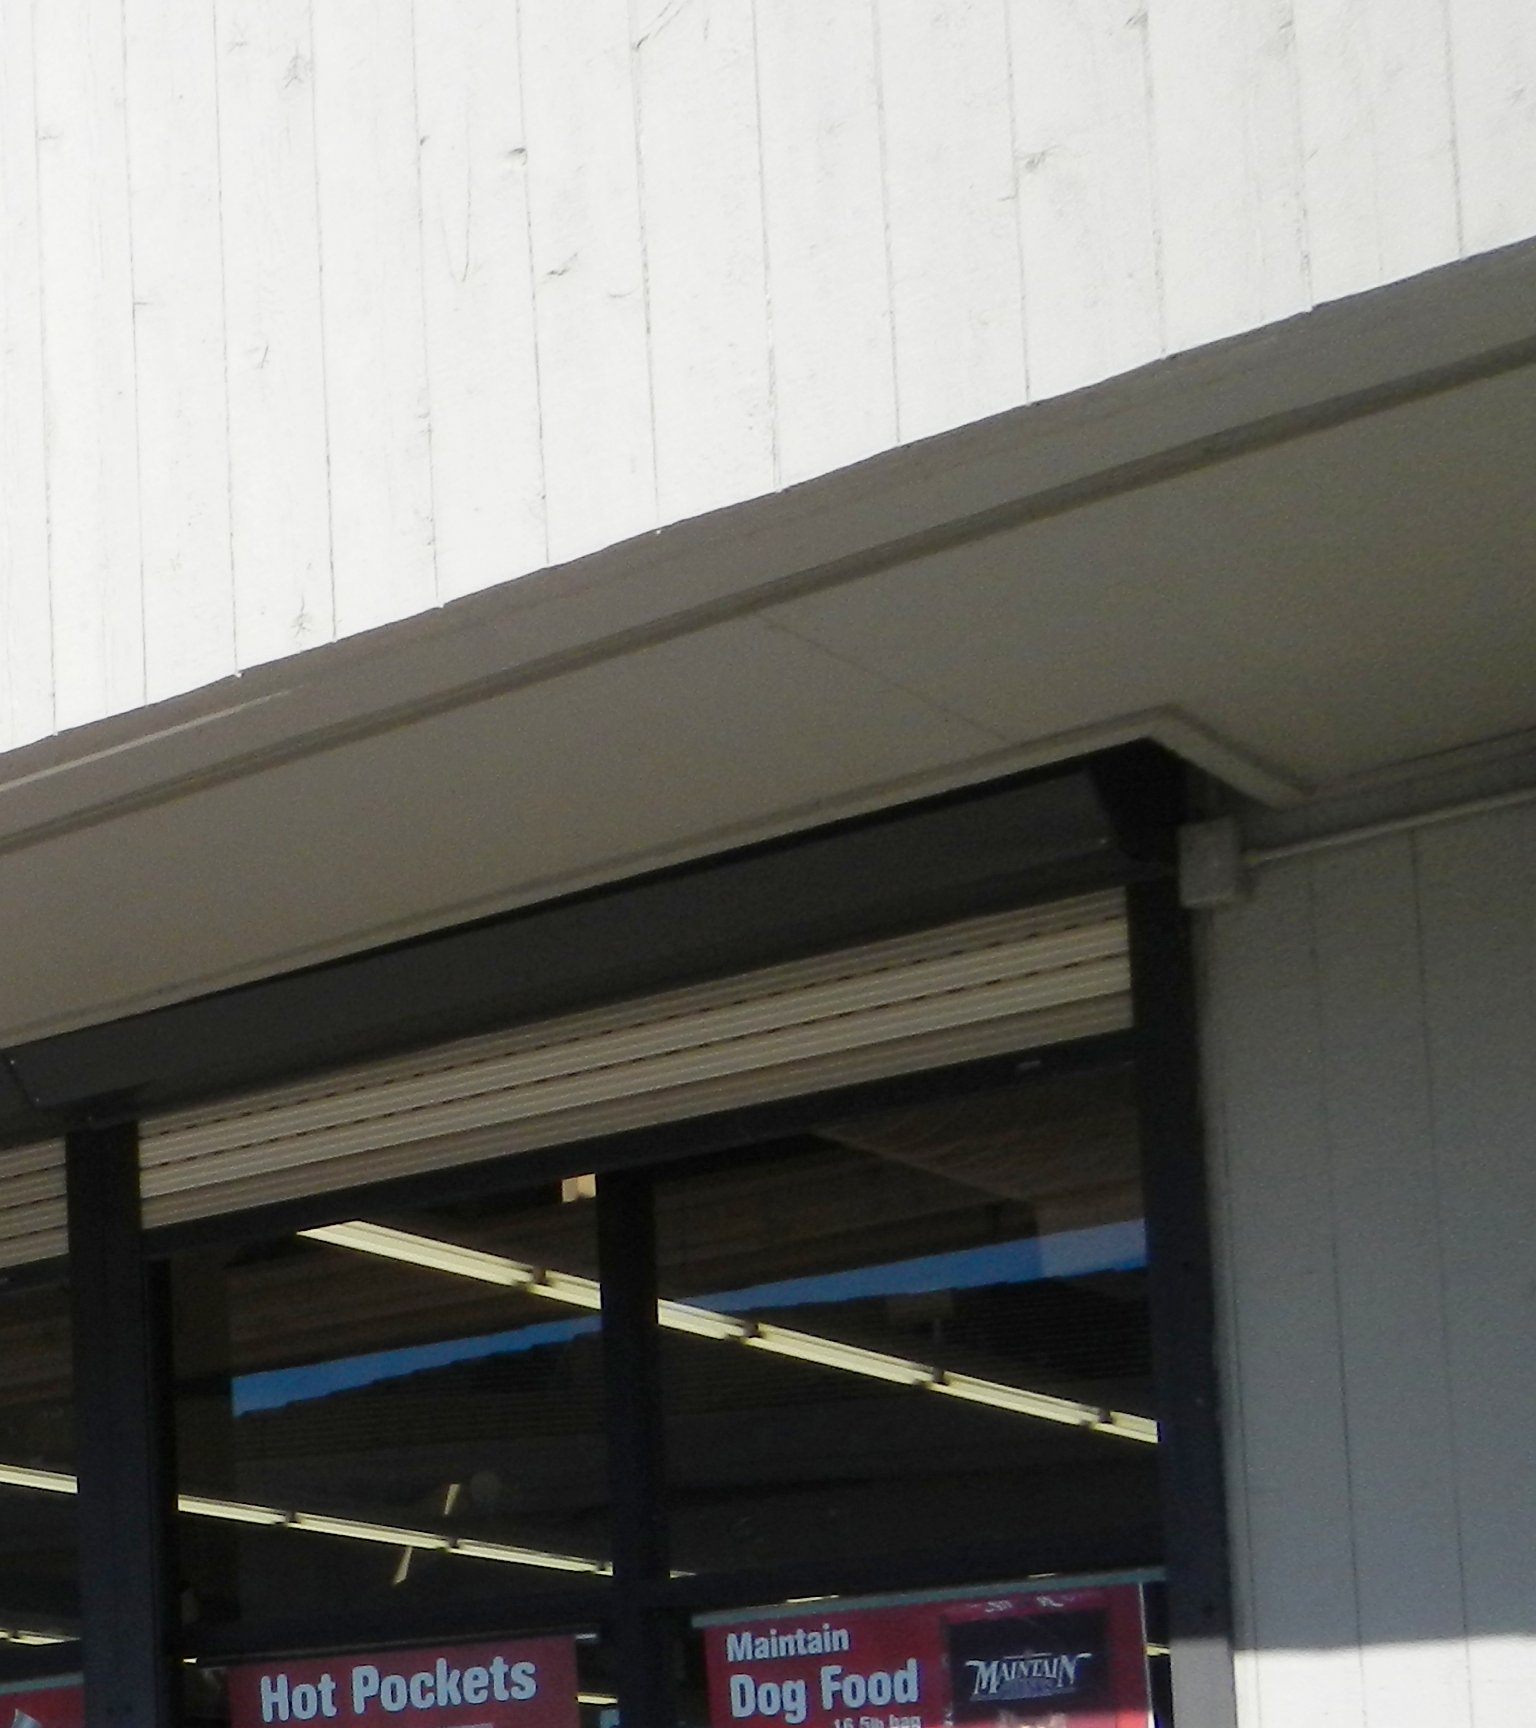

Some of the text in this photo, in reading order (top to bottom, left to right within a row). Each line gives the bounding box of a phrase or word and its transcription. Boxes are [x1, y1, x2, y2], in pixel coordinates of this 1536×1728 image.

[727, 1623, 849, 1662] Maintain
[260, 1656, 537, 1723] Hot Pockets
[730, 1658, 918, 1724] Dog Food
[966, 1652, 1092, 1696] MAINTAIN
